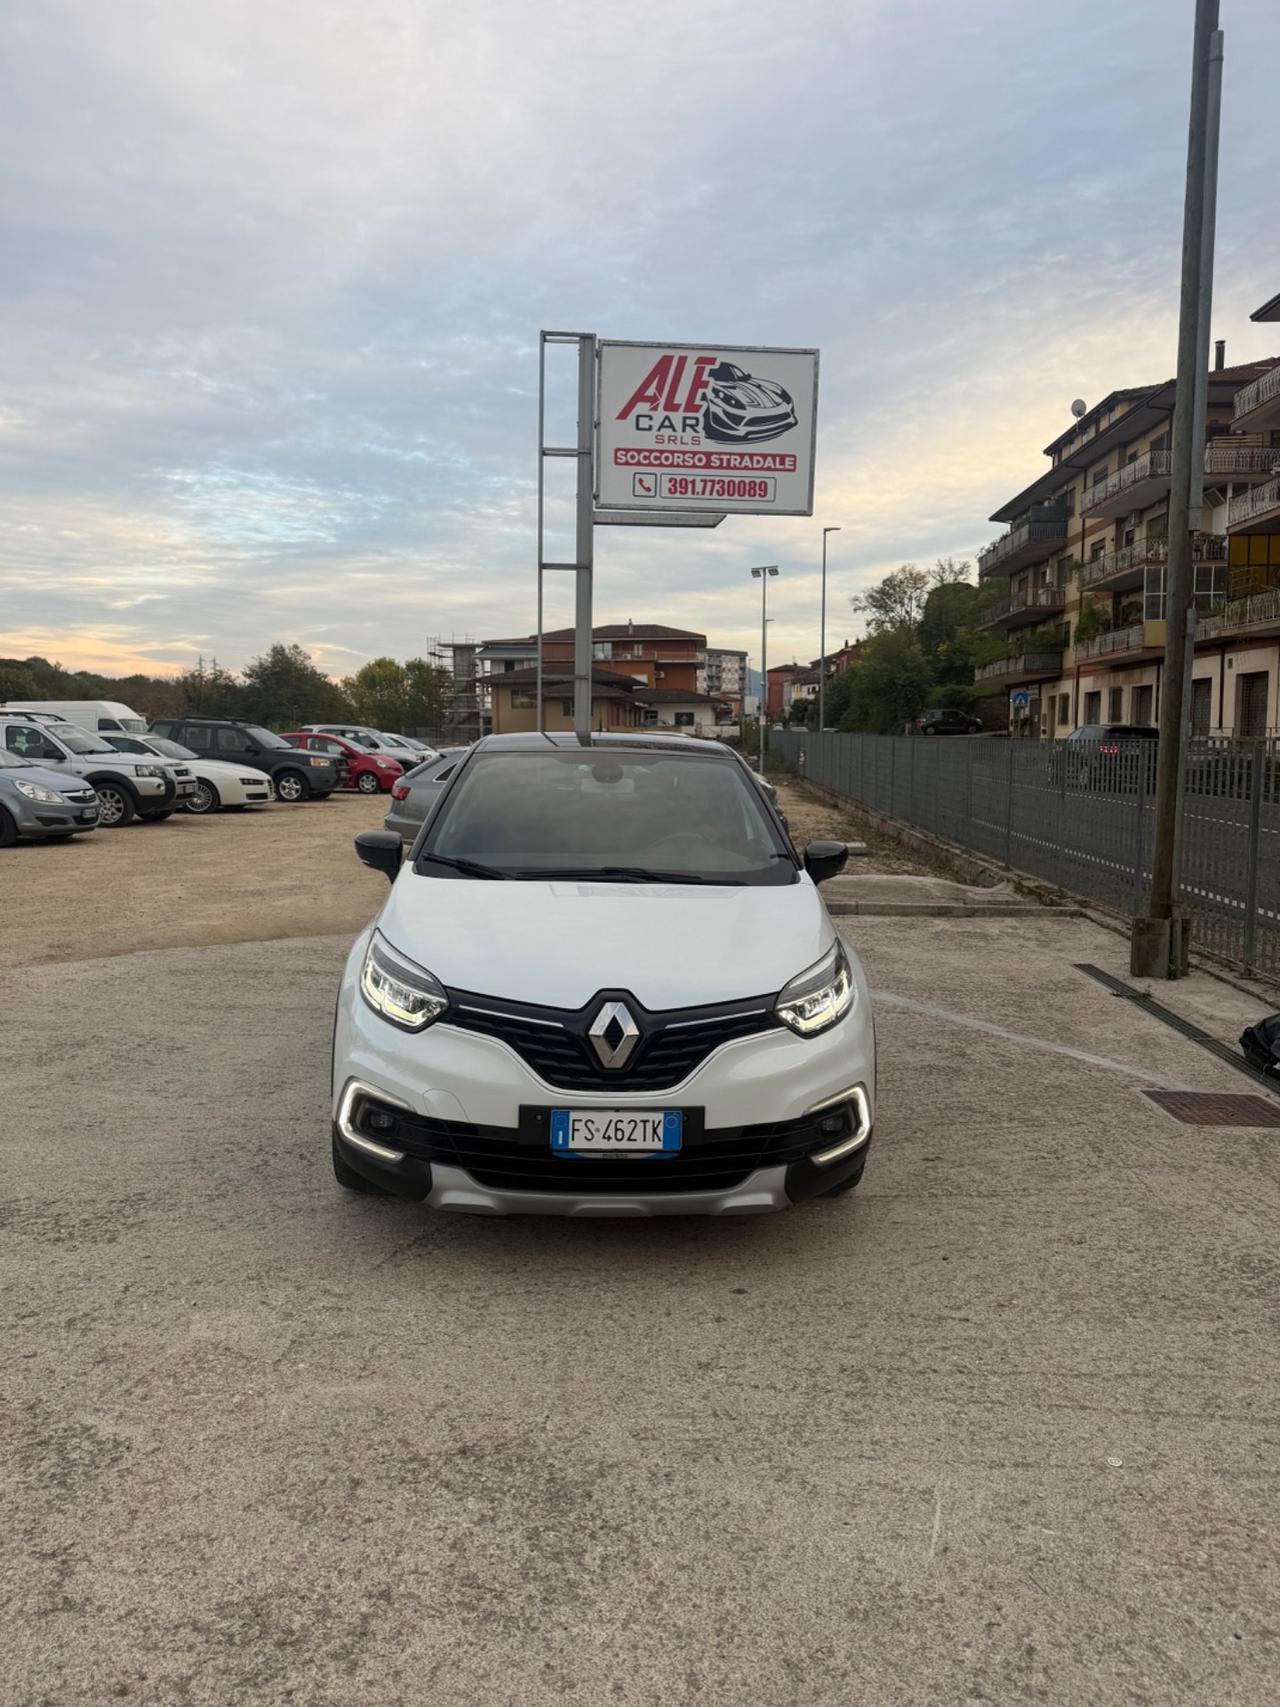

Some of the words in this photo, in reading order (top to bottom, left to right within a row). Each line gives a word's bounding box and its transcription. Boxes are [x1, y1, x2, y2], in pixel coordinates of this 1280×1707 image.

[616, 354, 717, 420] ALE
[635, 413, 700, 434] CAR
[655, 435, 702, 446] SRLS
[616, 451, 707, 466] SOCCORSO
[710, 454, 796, 470] STRADALE
[667, 477, 768, 498] 391.7730089
